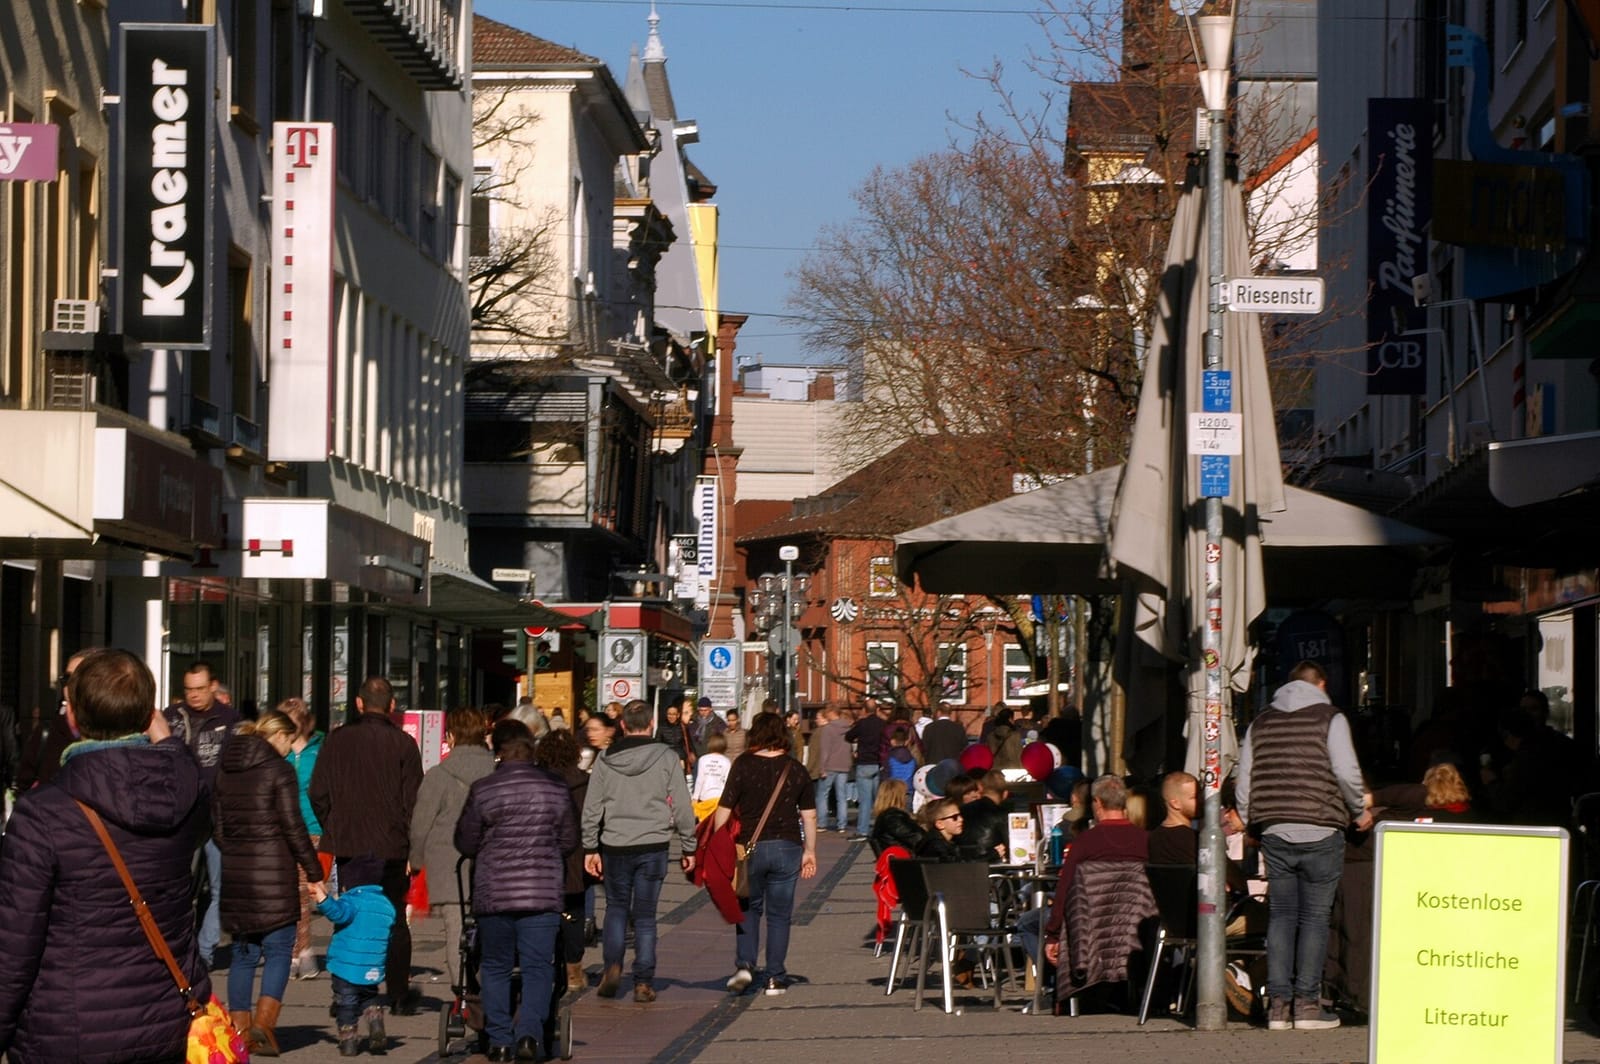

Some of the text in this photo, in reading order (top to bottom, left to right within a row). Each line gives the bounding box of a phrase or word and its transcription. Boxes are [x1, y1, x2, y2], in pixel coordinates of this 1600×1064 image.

[286, 127, 319, 168] T
[142, 57, 195, 317] Kraemer
[1378, 121, 1423, 297] Parfümerie
[1237, 284, 1316, 305] Riesenstr.
[1377, 341, 1424, 370] CB
[1198, 418, 1229, 427] H200
[1417, 891, 1523, 912] Kostenlose
[1416, 949, 1520, 969] Christliche
[1425, 1008, 1509, 1028] Literatur
